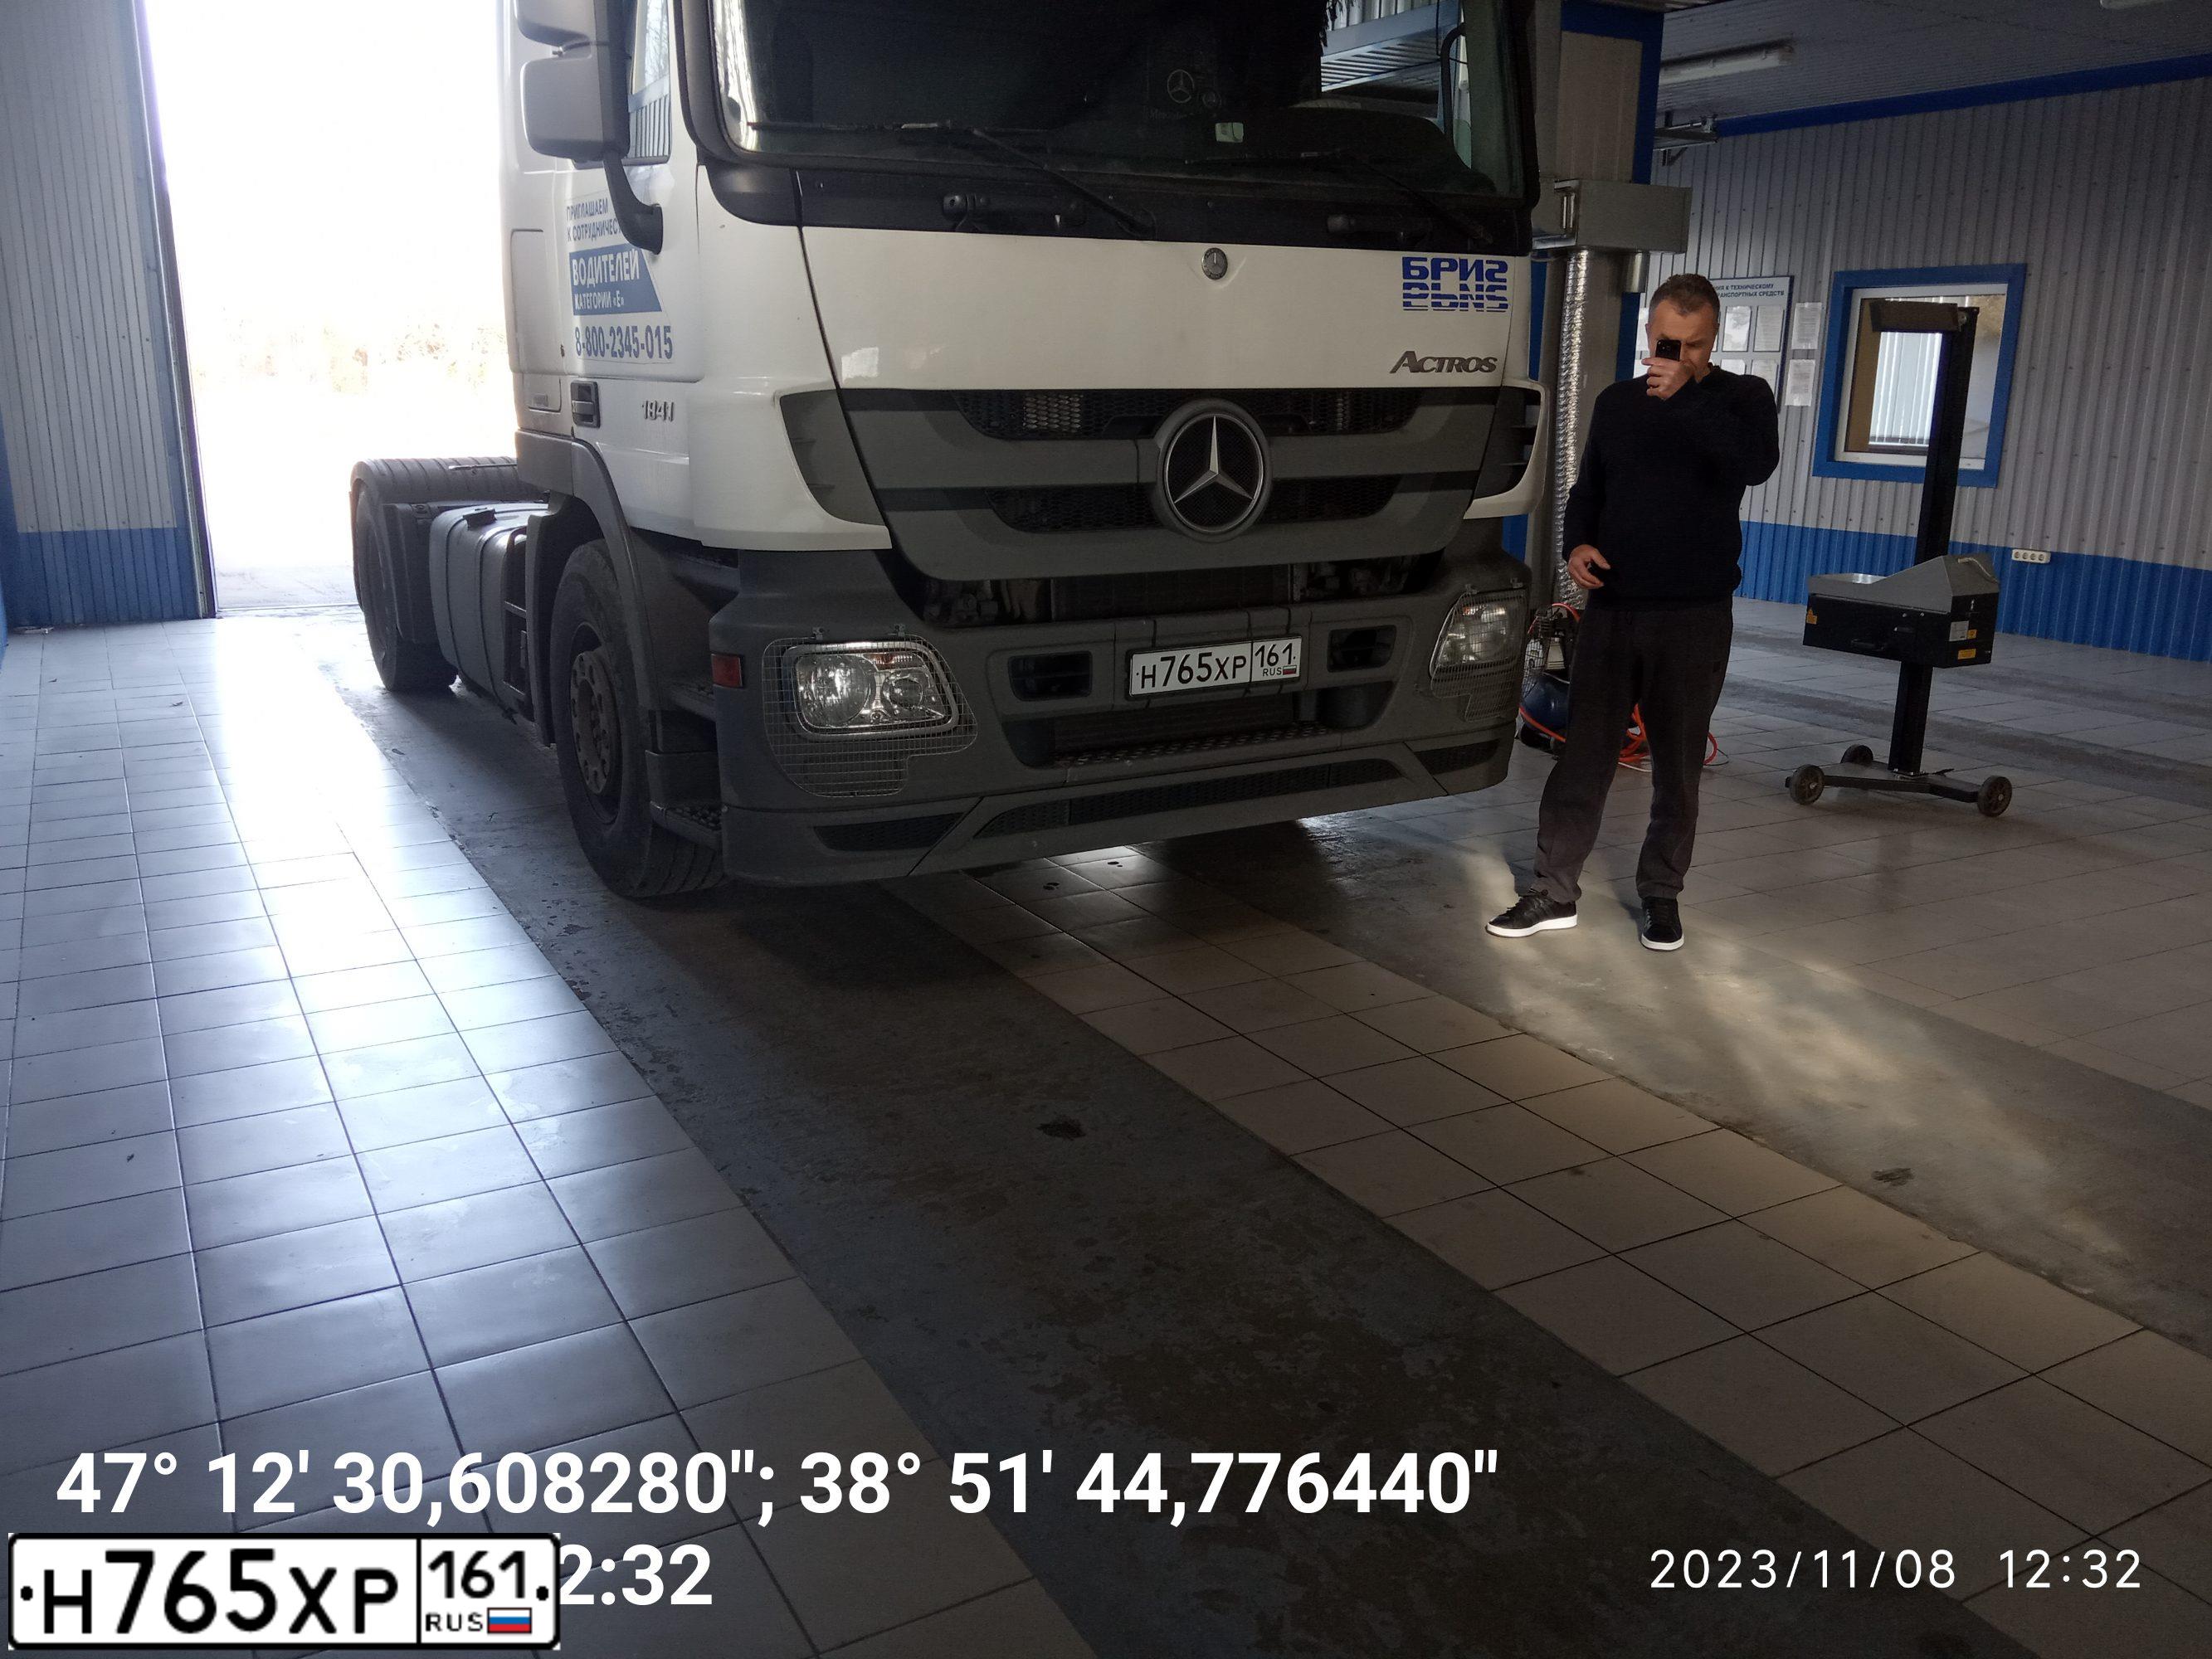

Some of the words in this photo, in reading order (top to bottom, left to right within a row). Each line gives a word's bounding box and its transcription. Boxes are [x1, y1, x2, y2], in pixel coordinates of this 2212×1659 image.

[567, 197, 608, 221] ПРИГЛАШАЕМ
[572, 217, 621, 241] СОТРУДНИЧЕС
[572, 248, 640, 289] ВОДИТЕЛЕЙ
[574, 291, 611, 310] КАТЕГОРИИ
[575, 324, 673, 359] 8-800-2345-015
[641, 400, 675, 422] 1841
[1255, 642, 1294, 669] 161
[1262, 667, 1282, 677] RUS
